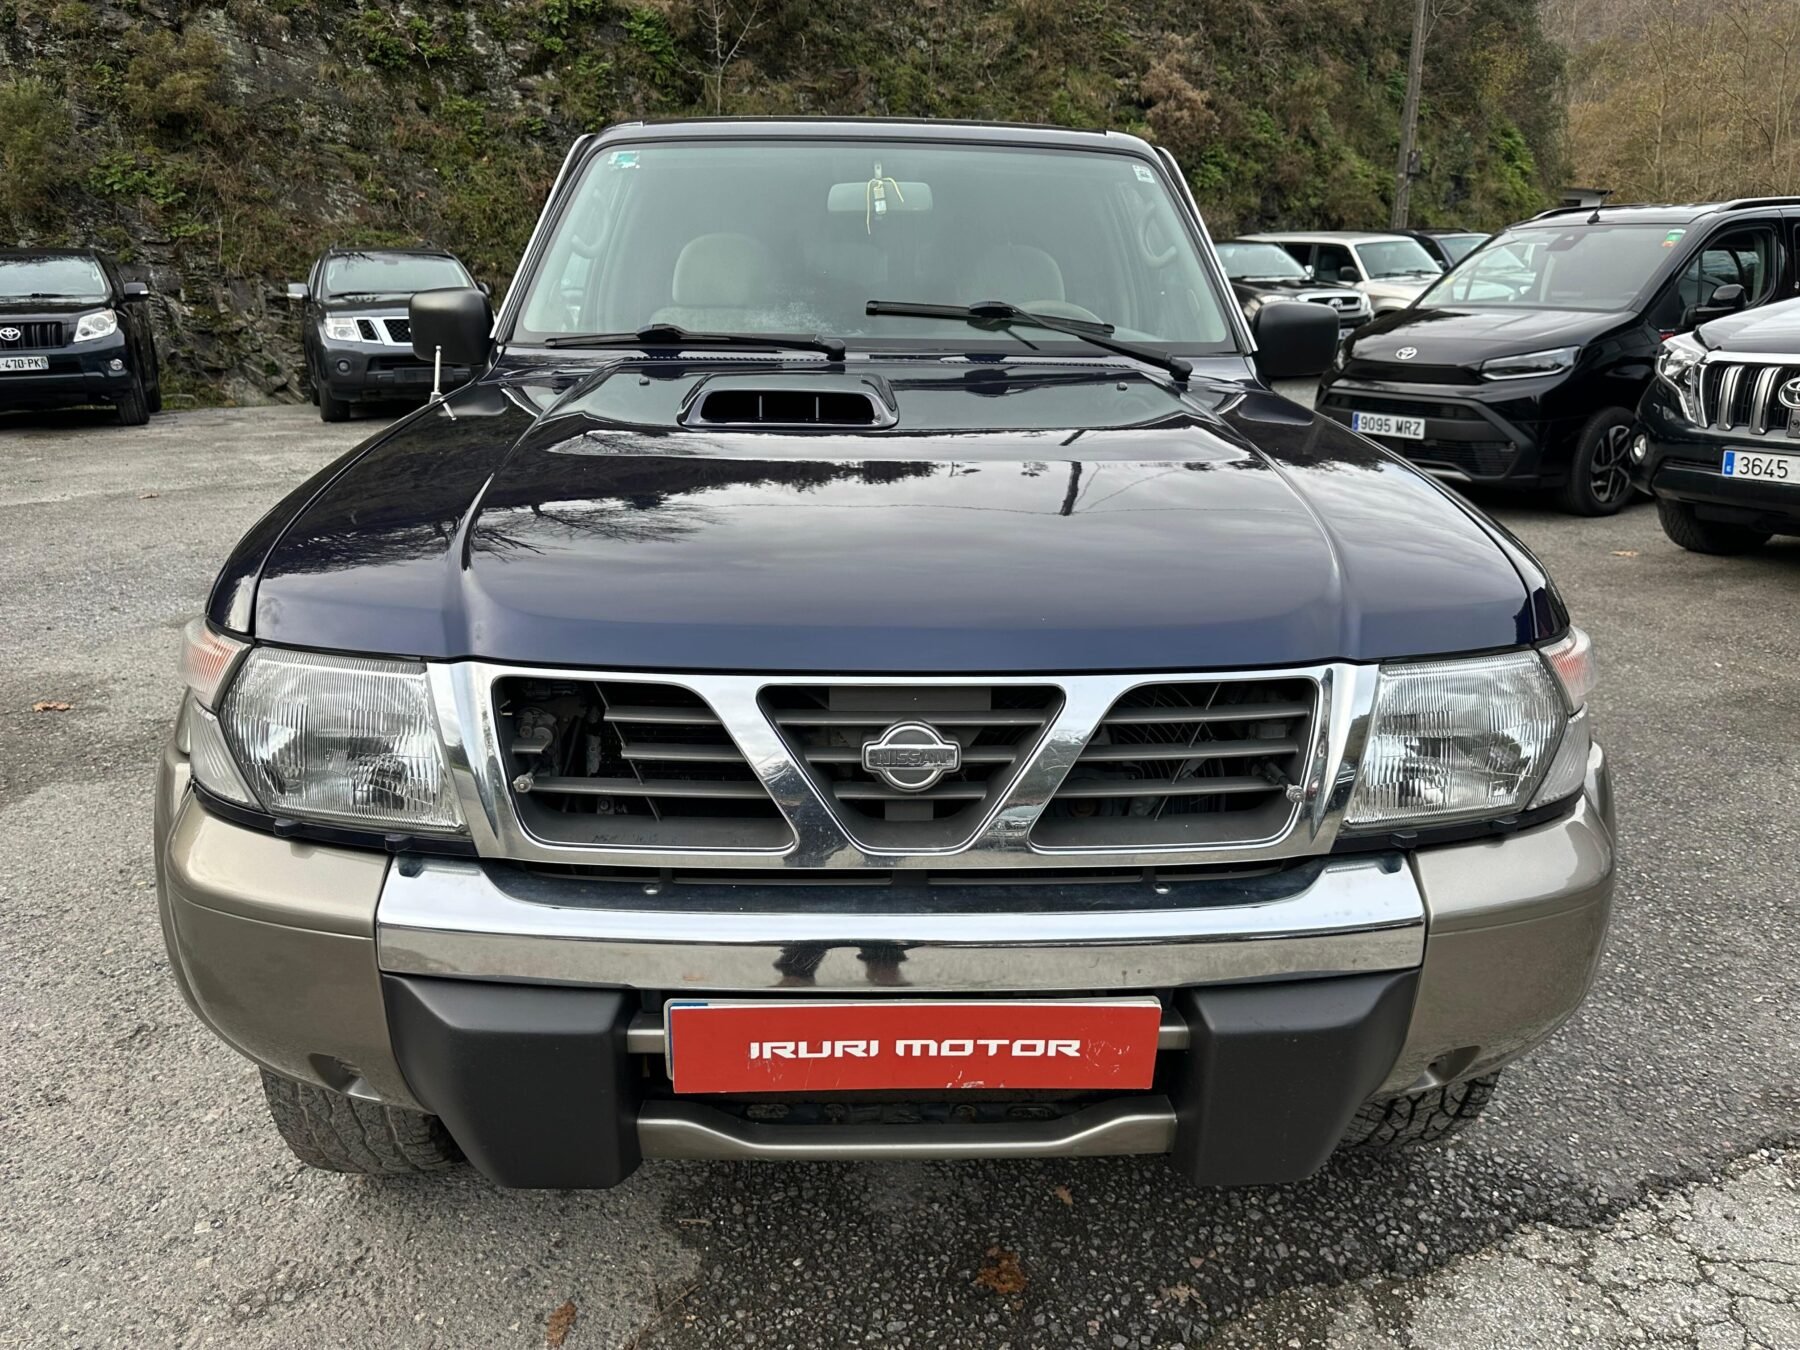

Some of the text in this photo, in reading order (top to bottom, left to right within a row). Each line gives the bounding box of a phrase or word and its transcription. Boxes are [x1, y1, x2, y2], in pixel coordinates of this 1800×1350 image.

[0, 358, 41, 369] -470-PK
[1361, 416, 1421, 436] 9095 MRZ
[1739, 456, 1788, 479] 3645
[876, 749, 950, 766] NISSAN
[750, 1040, 1081, 1059] IRURI MOTOR
